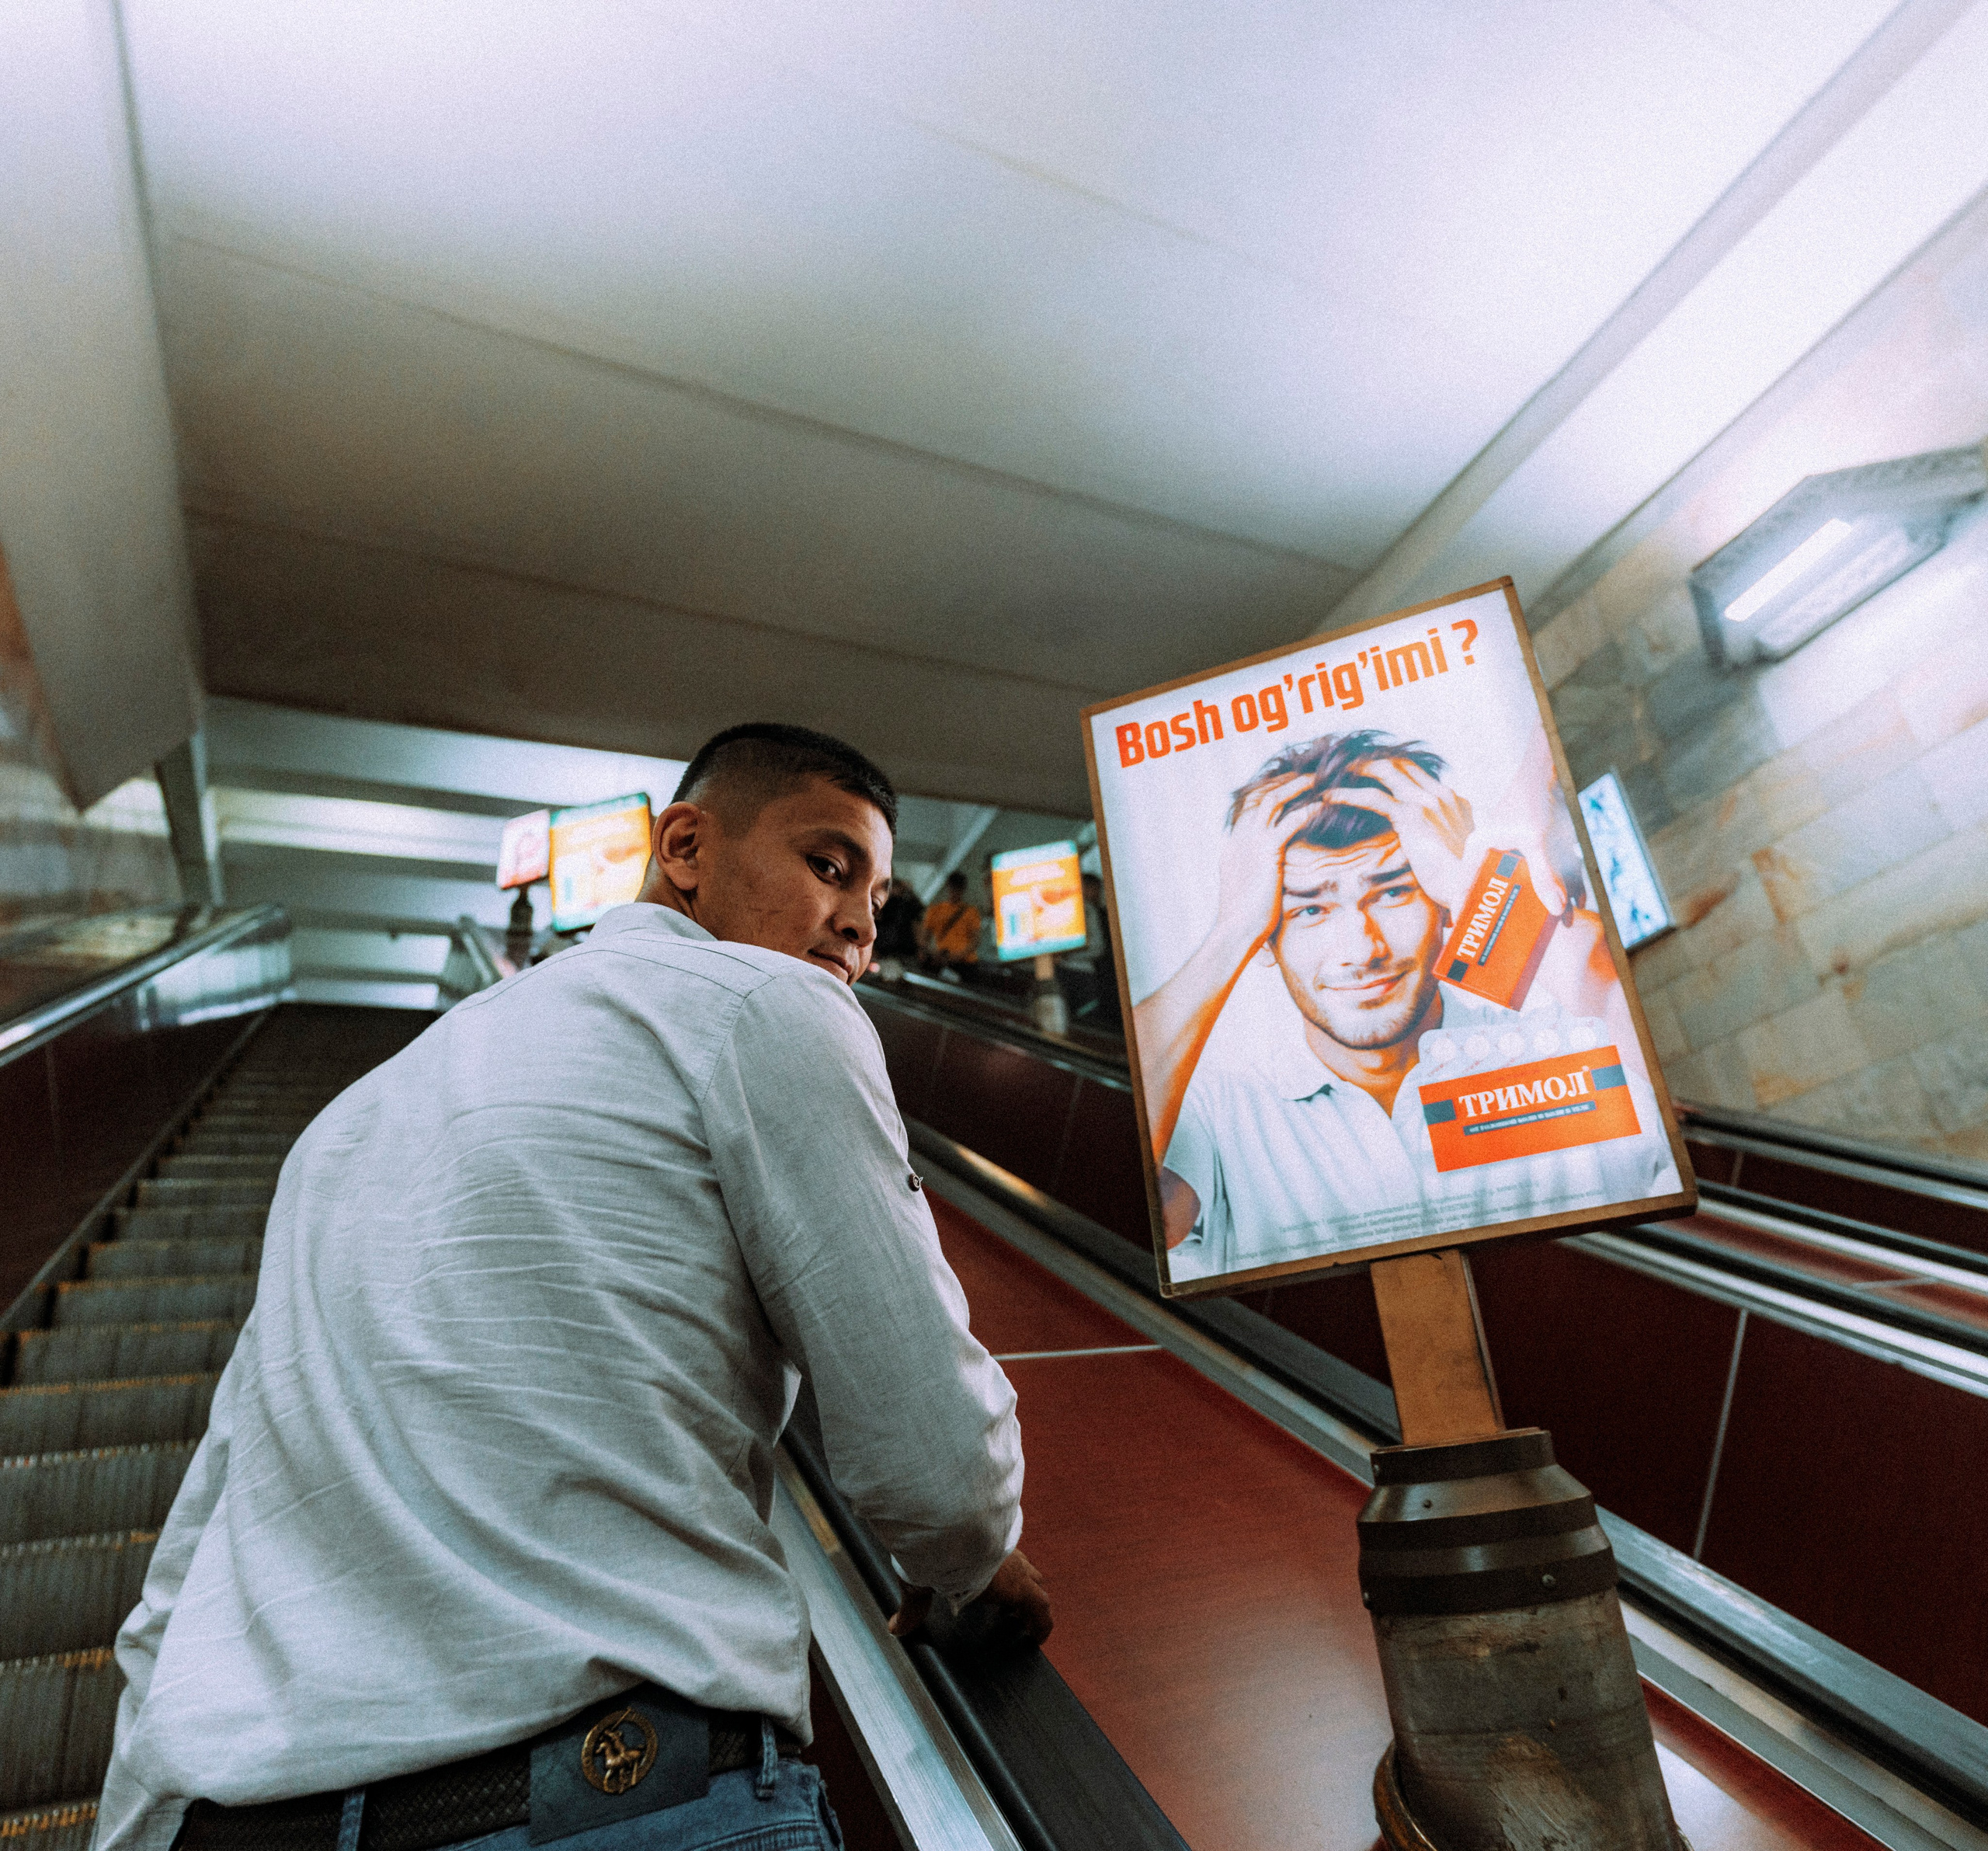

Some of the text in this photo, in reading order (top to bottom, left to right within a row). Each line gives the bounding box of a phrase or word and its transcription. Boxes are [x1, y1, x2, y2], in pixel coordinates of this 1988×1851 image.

[1115, 618, 1479, 768] Bosh og’rig’imi ?
[1455, 875, 1509, 959] ТРИМОЛ
[1459, 1070, 1590, 1117] ТРИМОЛ
